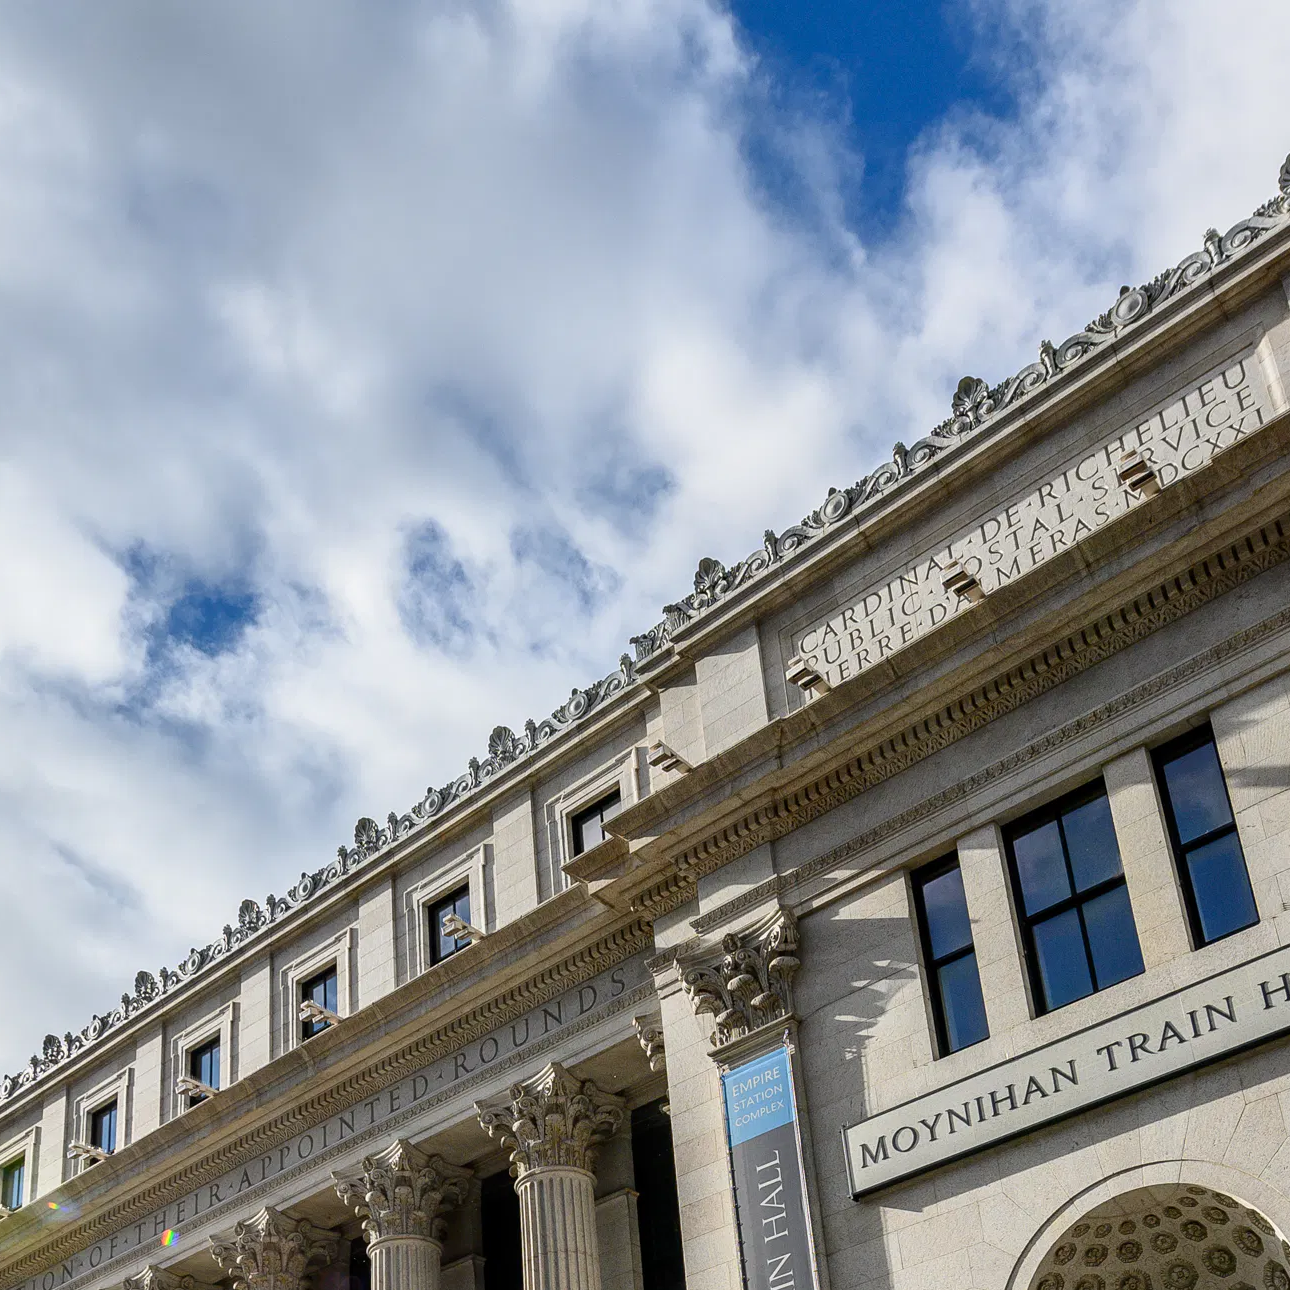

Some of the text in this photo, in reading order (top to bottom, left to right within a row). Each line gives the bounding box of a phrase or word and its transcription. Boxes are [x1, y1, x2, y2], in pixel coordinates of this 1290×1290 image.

[978, 502, 1022, 545] DE
[1036, 360, 1247, 509] RICHELIEU
[941, 502, 1074, 597] OSTAL
[89, 1237, 120, 1267] OF
[134, 1182, 227, 1245] THEIR
[238, 1075, 430, 1192] APPOINTED
[452, 967, 626, 1082] ROUNDS
[732, 1066, 781, 1098] EMPIRE
[733, 1083, 783, 1113] STATION
[735, 1099, 785, 1127] COMPLEX
[859, 1059, 1079, 1168] MOYNIHAN
[1096, 996, 1237, 1072] TRAIN
[755, 1149, 789, 1246] HALL
